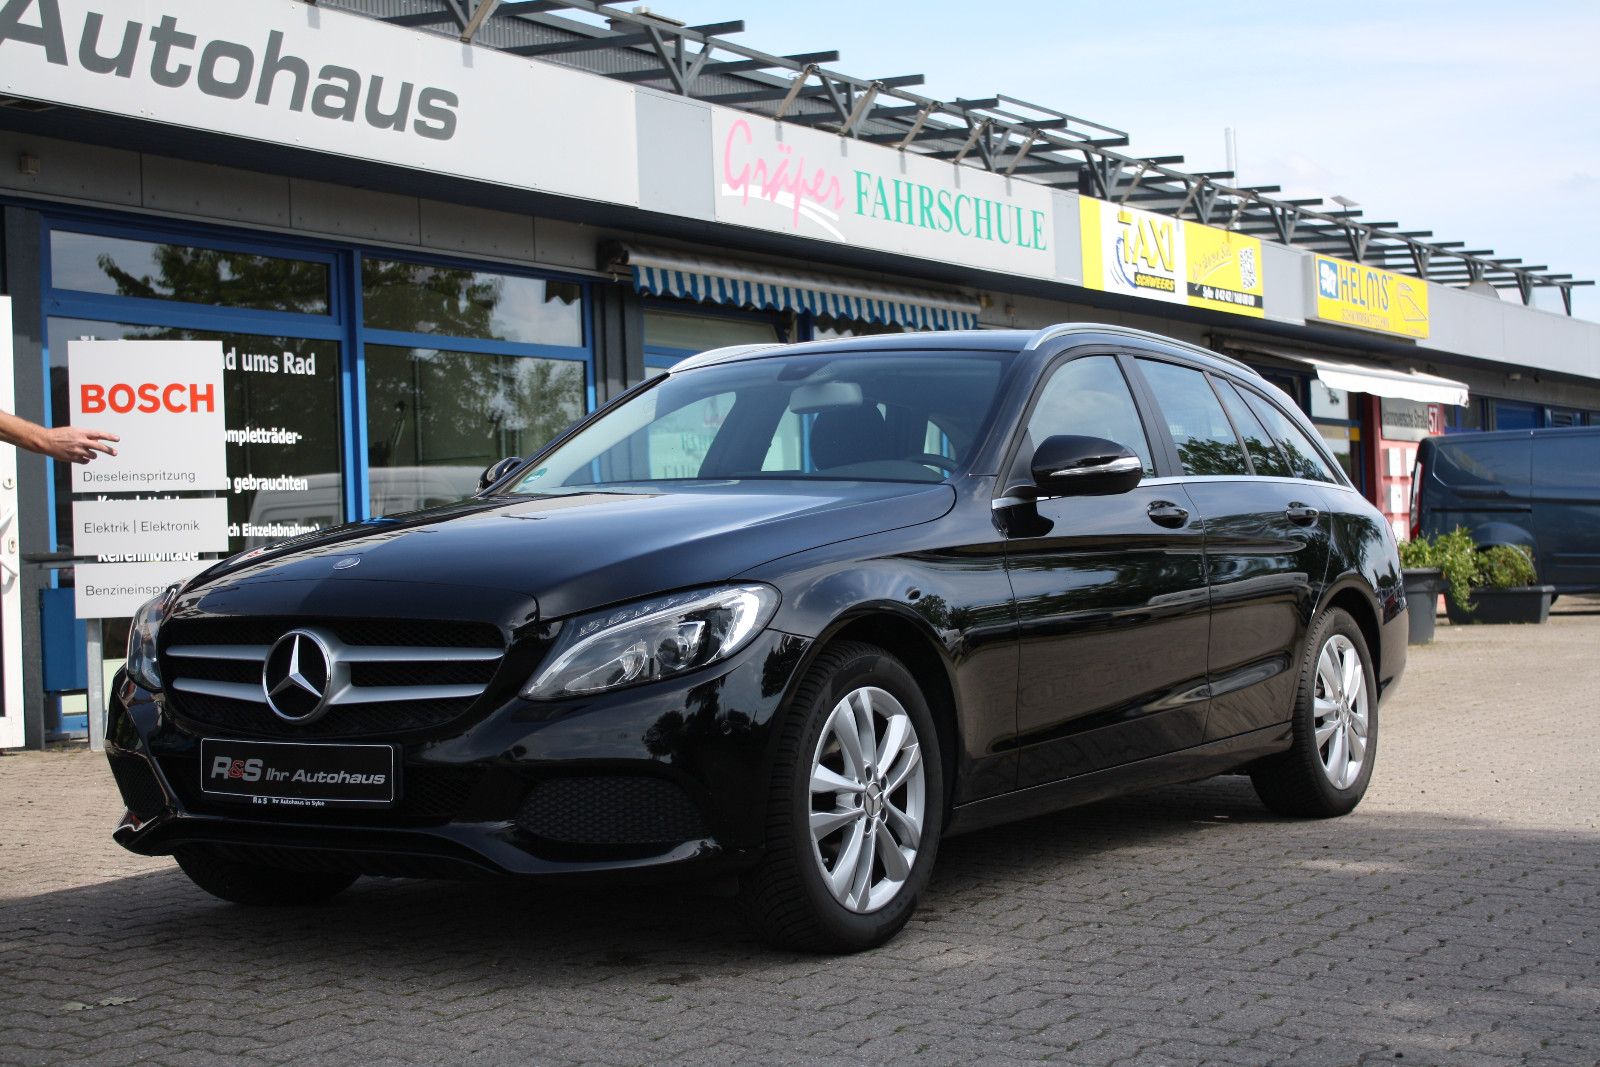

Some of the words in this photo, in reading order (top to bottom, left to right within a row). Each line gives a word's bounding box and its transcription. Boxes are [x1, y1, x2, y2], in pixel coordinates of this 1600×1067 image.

[0, 0, 459, 141] Autohaus
[854, 169, 1048, 251] FAHRSCHULE
[242, 353, 278, 373] ums
[283, 351, 316, 375] Rad
[81, 383, 214, 413] BOSCH
[224, 427, 302, 446] mpletträder-
[83, 470, 196, 483] Dieseleinspritzung
[234, 474, 308, 493] gebrauchten
[84, 522, 129, 534] Elektrik
[141, 519, 200, 532] Elektronik
[265, 767, 289, 781] Ihr
[291, 769, 386, 785] Autohaus
